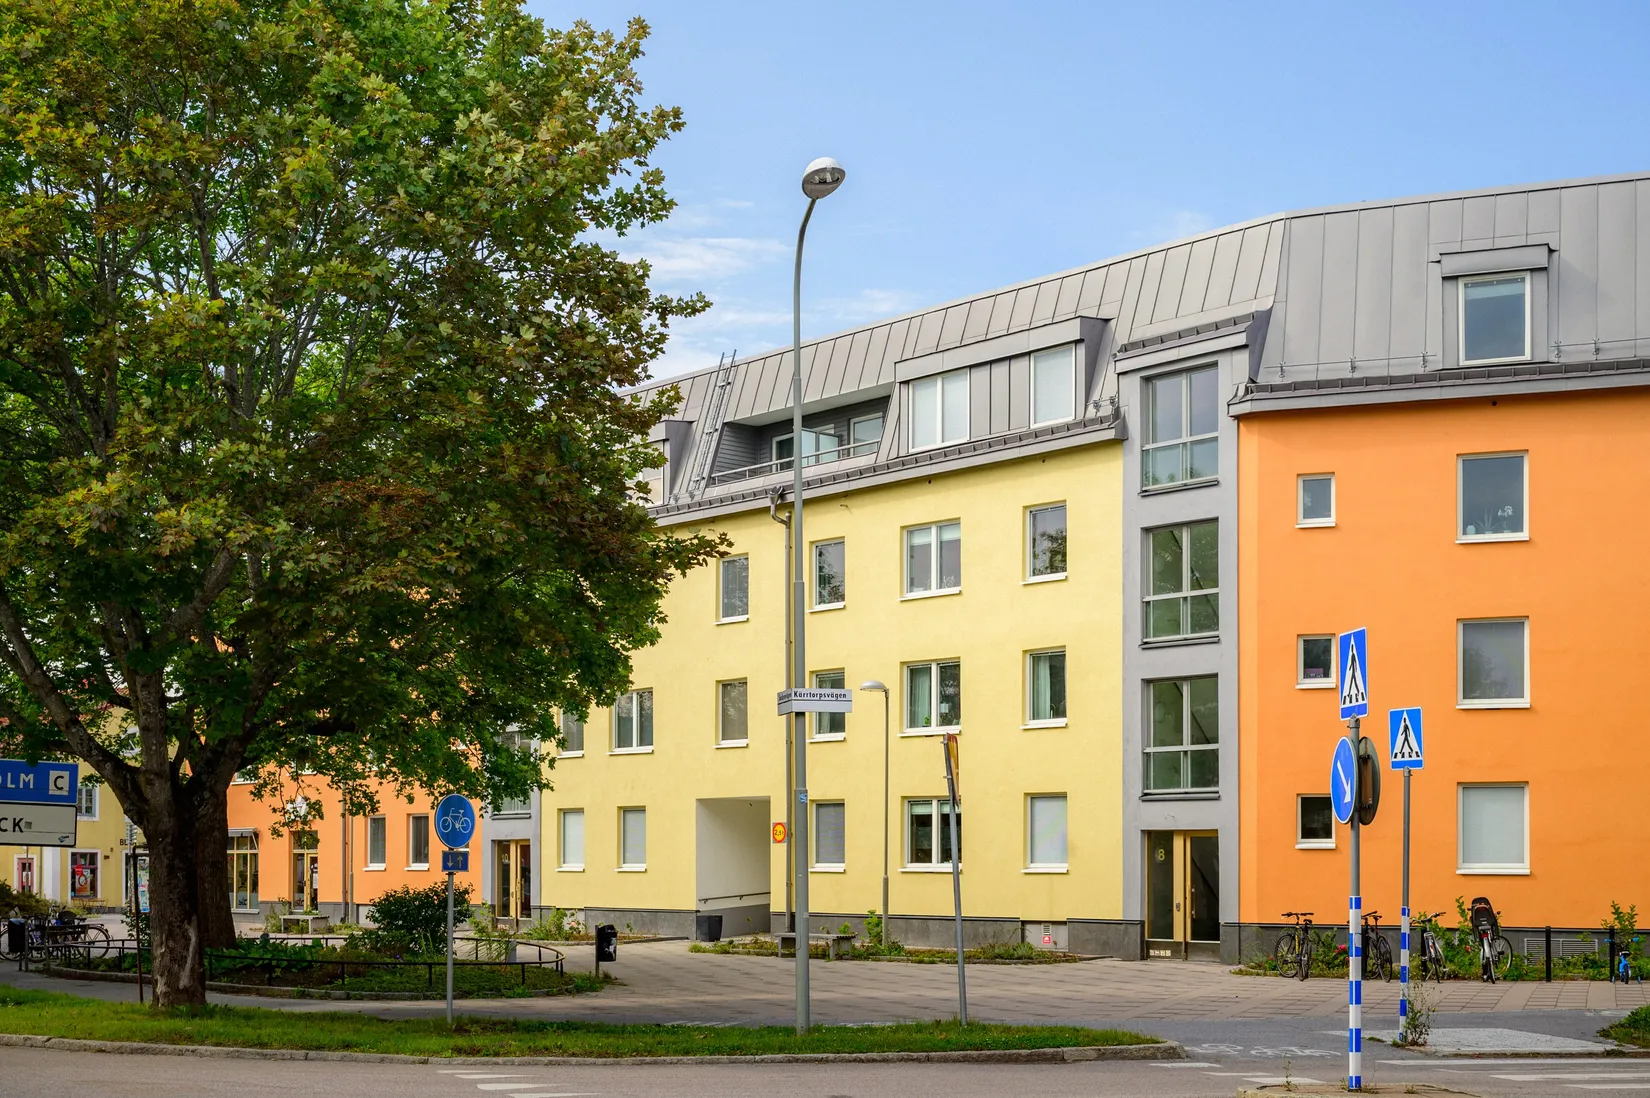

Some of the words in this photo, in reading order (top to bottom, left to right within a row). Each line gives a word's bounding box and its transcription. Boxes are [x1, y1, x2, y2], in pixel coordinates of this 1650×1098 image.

[0, 772, 34, 789] LM
[54, 776, 64, 790] C
[1158, 849, 1165, 860] 8
